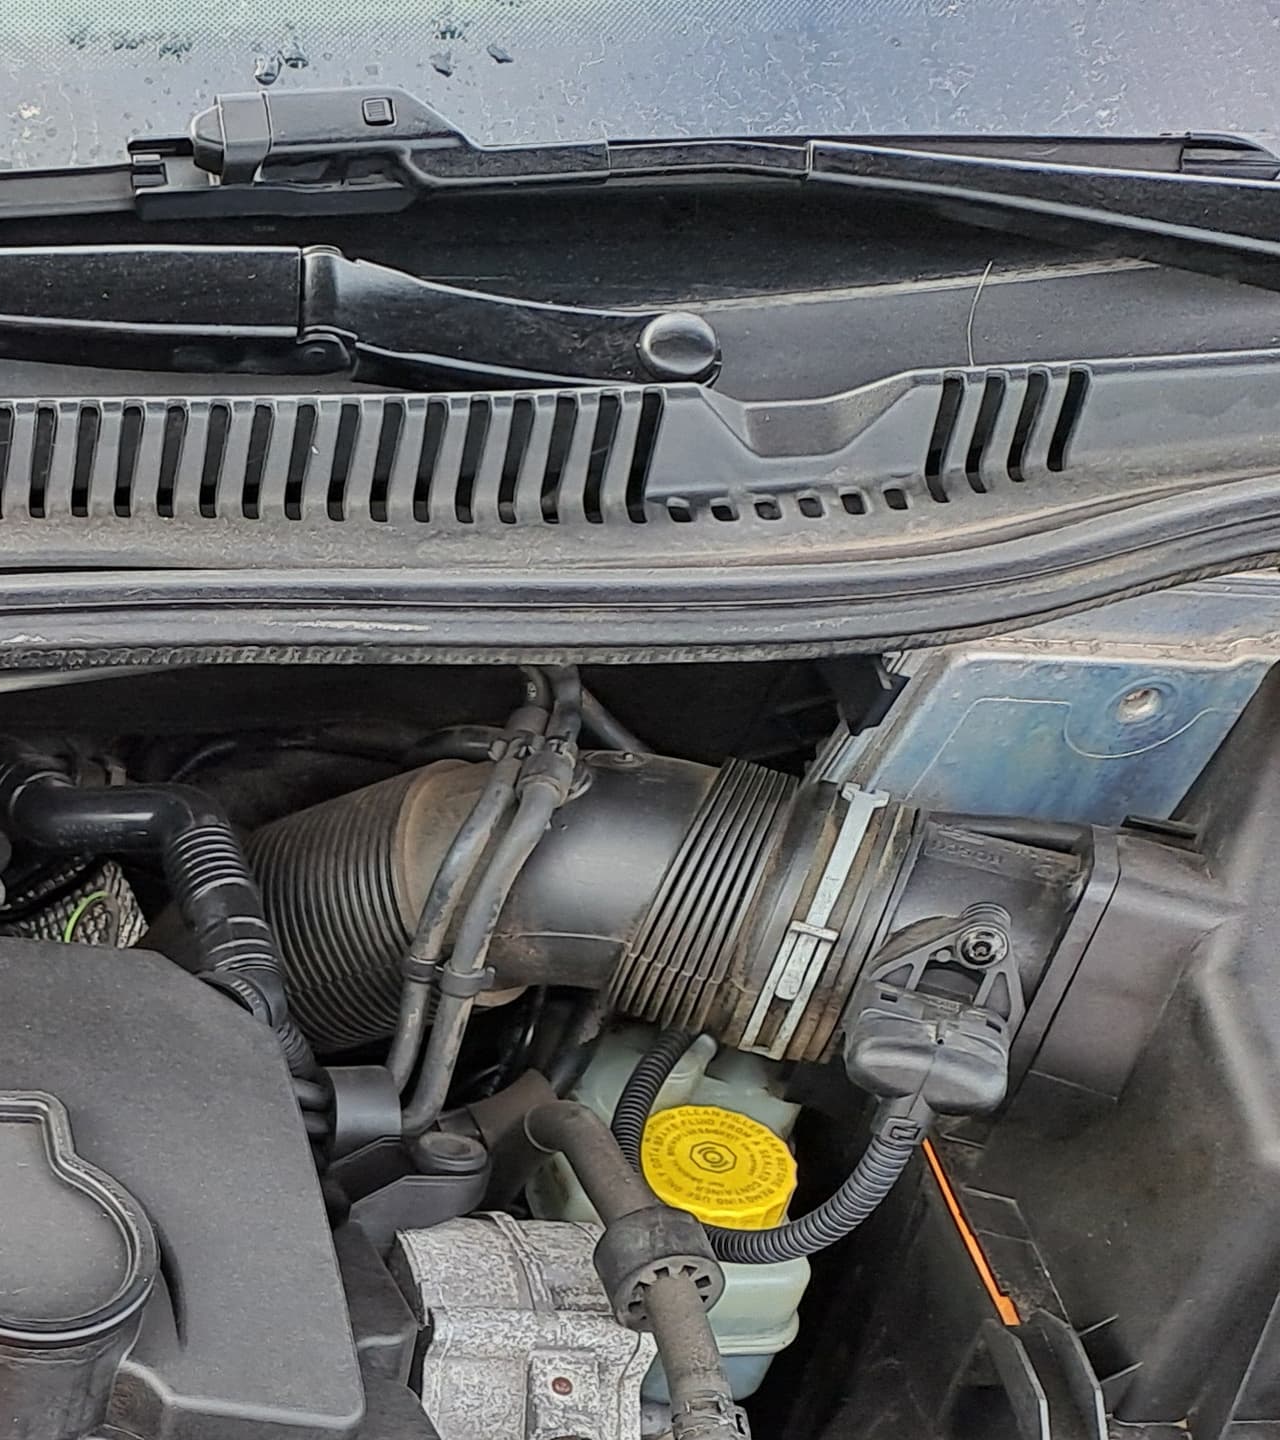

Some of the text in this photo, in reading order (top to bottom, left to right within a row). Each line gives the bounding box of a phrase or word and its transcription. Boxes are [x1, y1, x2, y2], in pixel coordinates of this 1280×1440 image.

[678, 1108, 721, 1118] CLEAN
[680, 1117, 716, 1128] FLUID
[723, 1111, 766, 1135] FILLER
[718, 1119, 753, 1140] FROM
[762, 1135, 785, 1157] CAP
[715, 1185, 776, 1206] REMOVING
